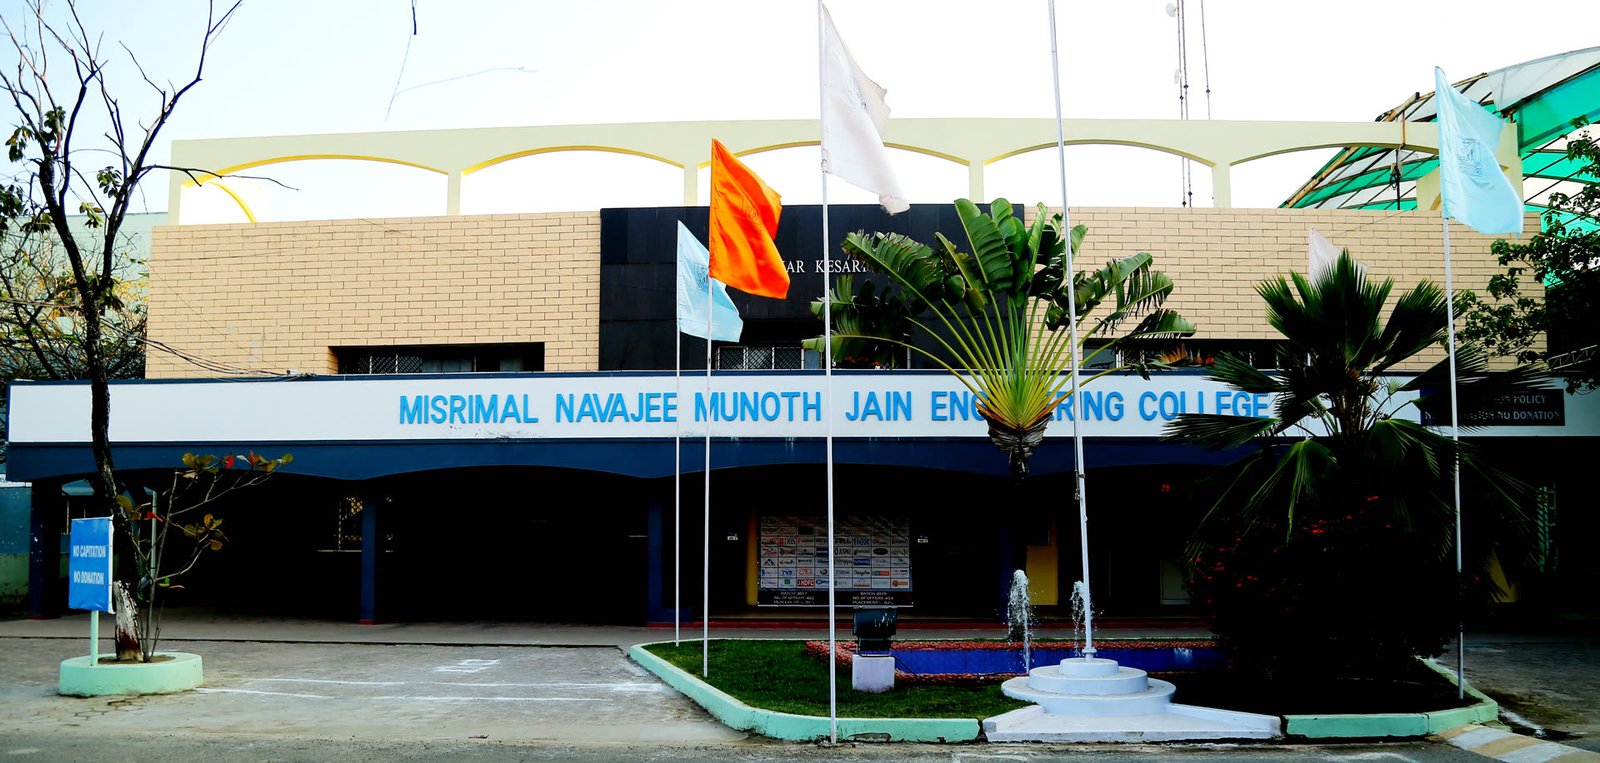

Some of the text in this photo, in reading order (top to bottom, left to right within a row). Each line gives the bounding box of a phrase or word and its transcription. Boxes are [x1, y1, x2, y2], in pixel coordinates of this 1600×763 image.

[399, 394, 538, 425] MISRIMAL
[555, 393, 678, 423] NAVAJEE
[694, 391, 821, 422] MUNOTH
[845, 391, 912, 422] JAIN
[1513, 411, 1560, 420] DONATION
[73, 545, 106, 558] NO CAPITATION
[73, 571, 104, 584] NO DONATION
